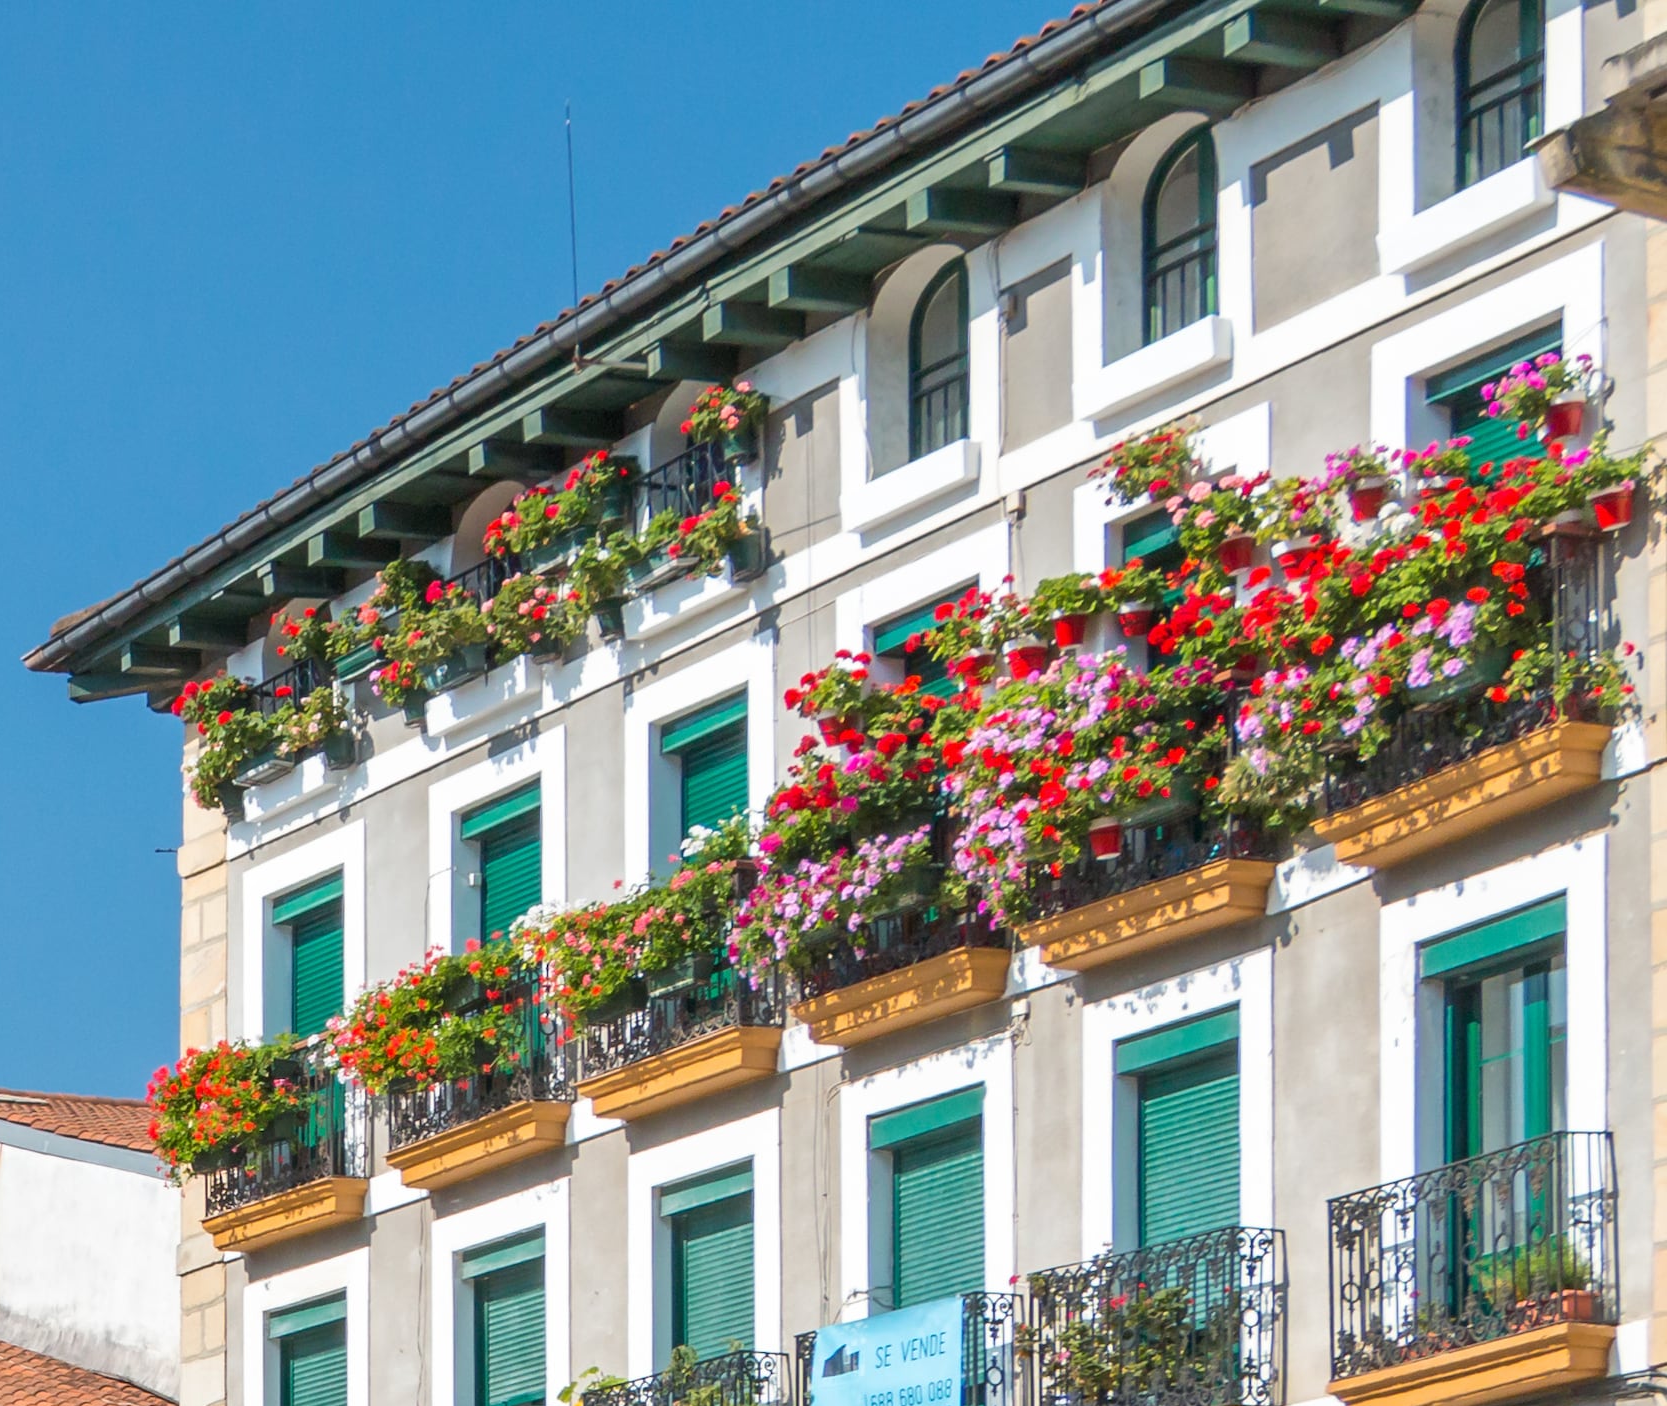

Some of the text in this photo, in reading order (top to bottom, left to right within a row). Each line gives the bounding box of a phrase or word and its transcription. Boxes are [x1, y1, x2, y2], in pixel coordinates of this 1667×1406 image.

[875, 1332, 946, 1368] SE VENDE
[928, 1378, 953, 1401] 088
